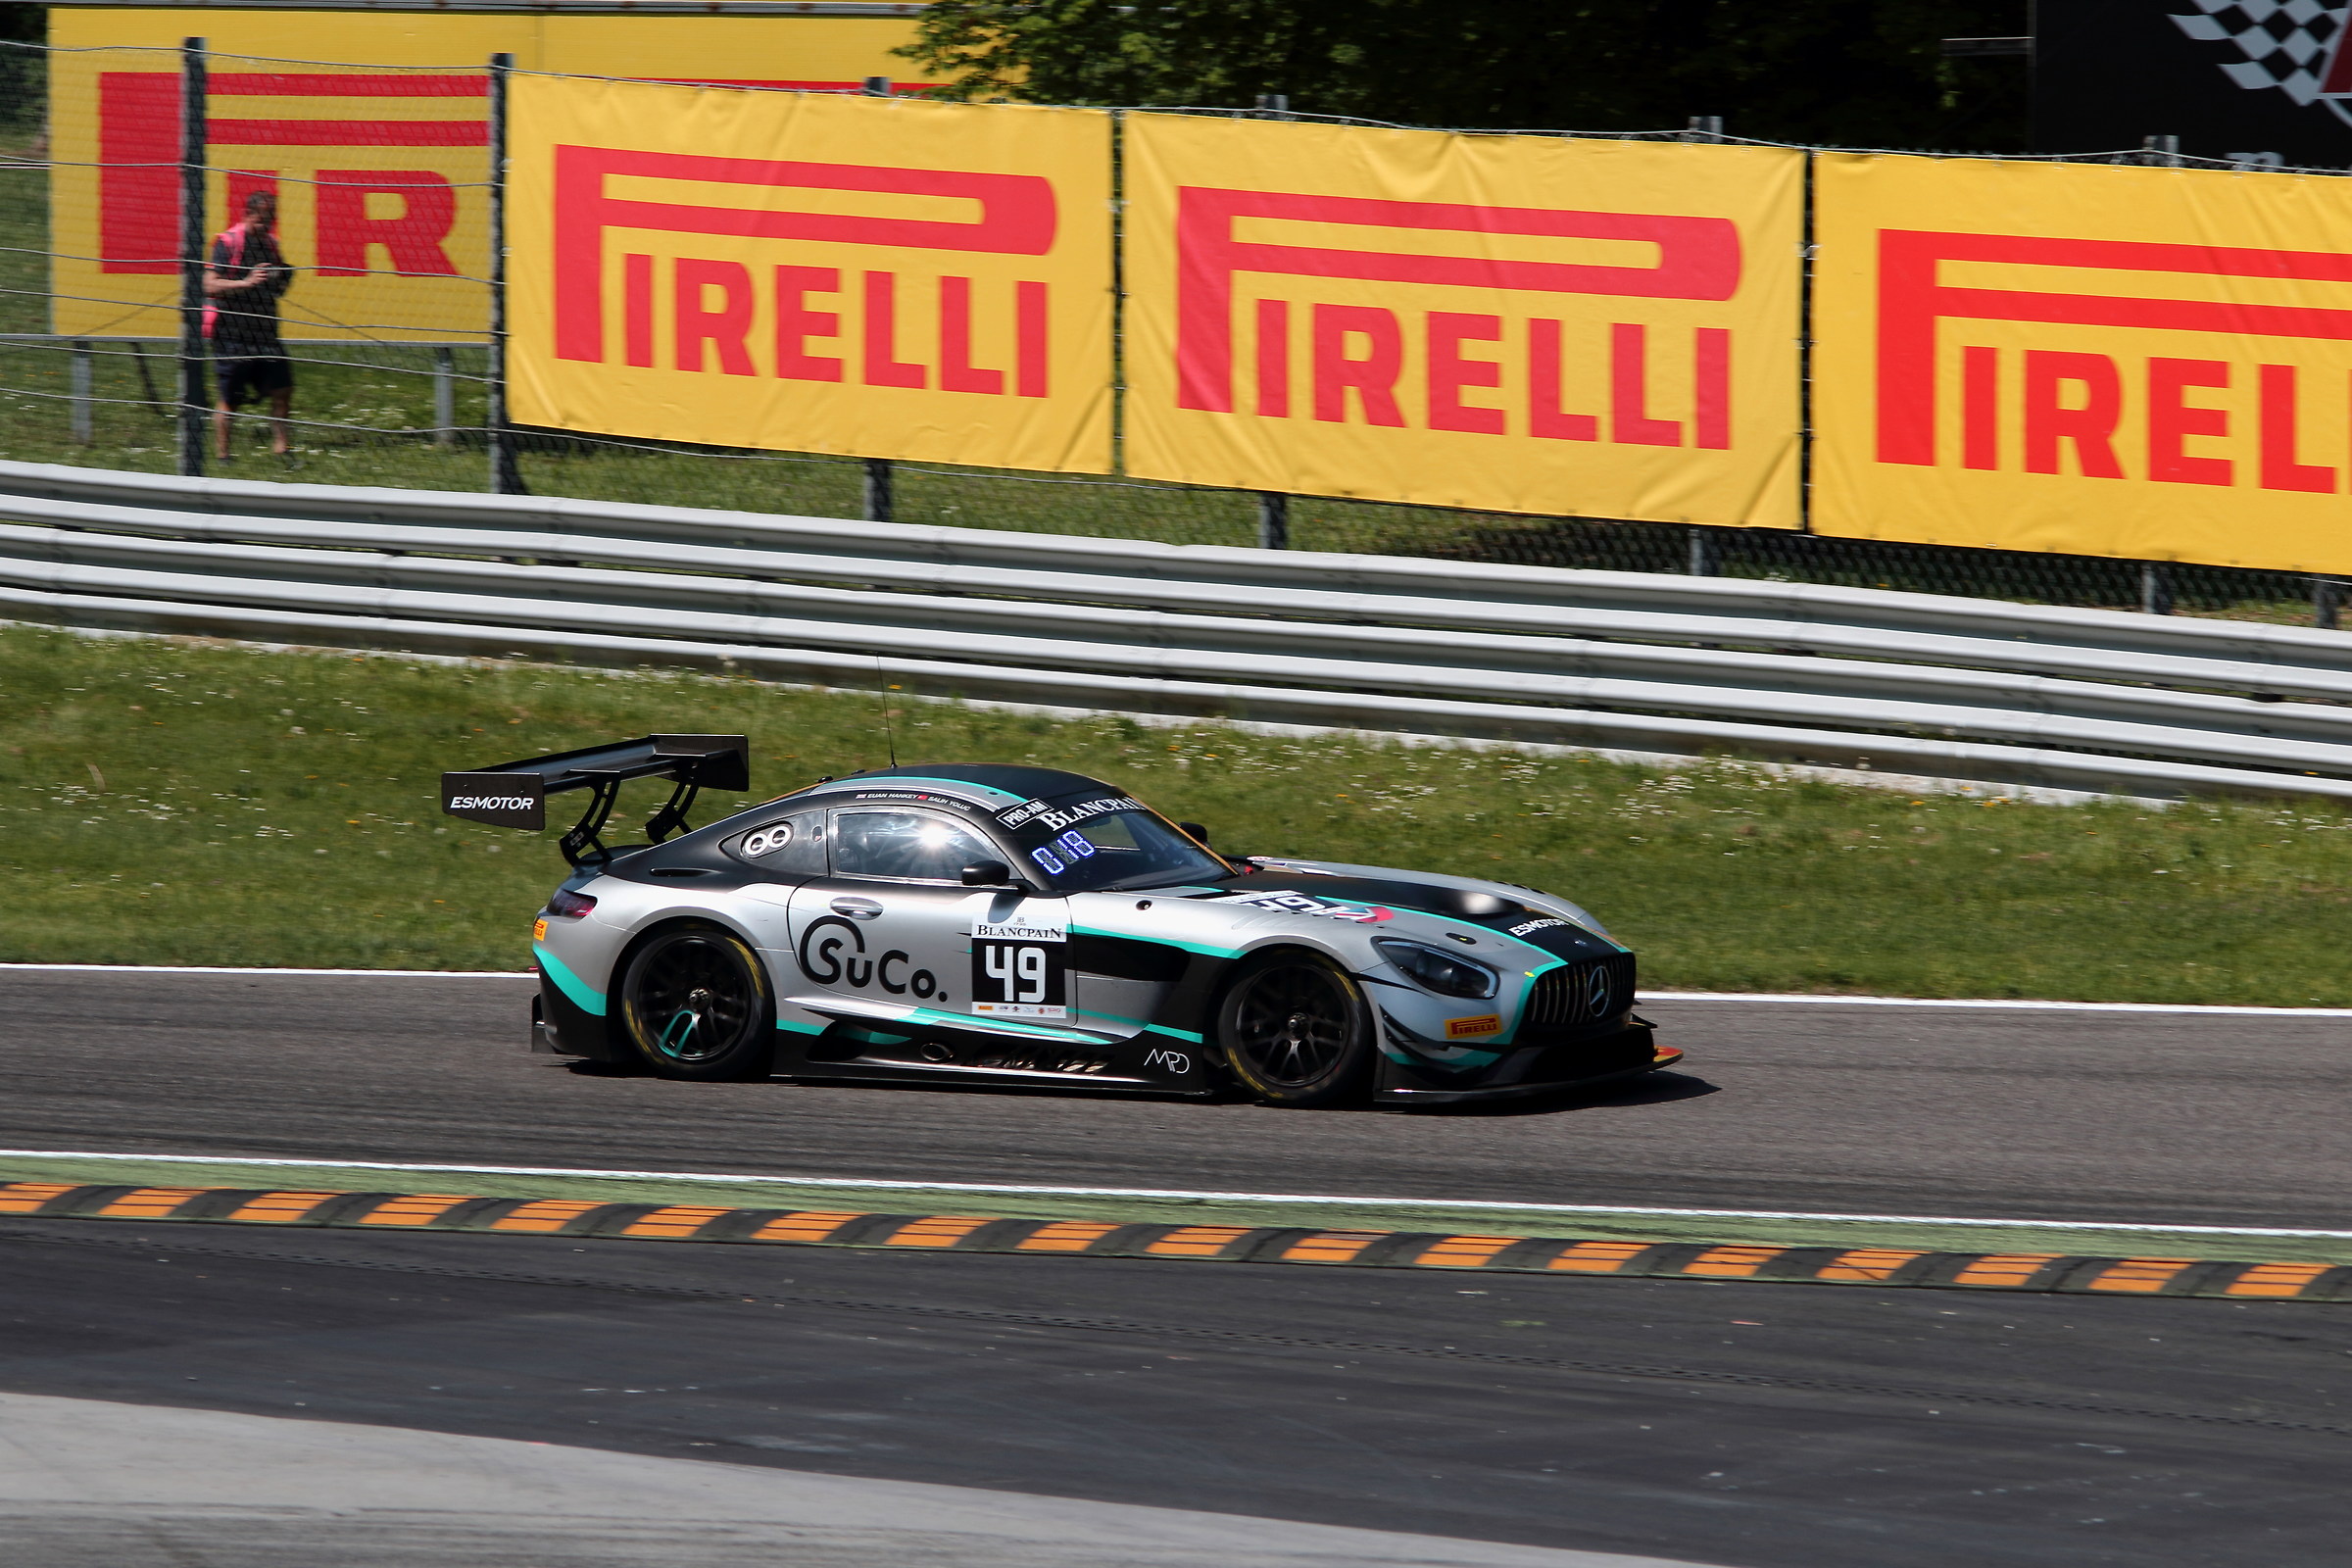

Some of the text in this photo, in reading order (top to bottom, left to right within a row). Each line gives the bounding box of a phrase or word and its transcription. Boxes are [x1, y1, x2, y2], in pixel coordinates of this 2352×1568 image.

[553, 143, 1058, 399] PIRELLI
[1176, 185, 1741, 450] PIRELLI
[1876, 228, 2352, 496] PIREL
[450, 796, 534, 809] ESMOTOR
[1003, 801, 1049, 825] PRO-AM
[977, 925, 1061, 938] BLANCPAIN
[986, 945, 1046, 1004] 49
[1450, 1017, 1496, 1035] PIRELLI
